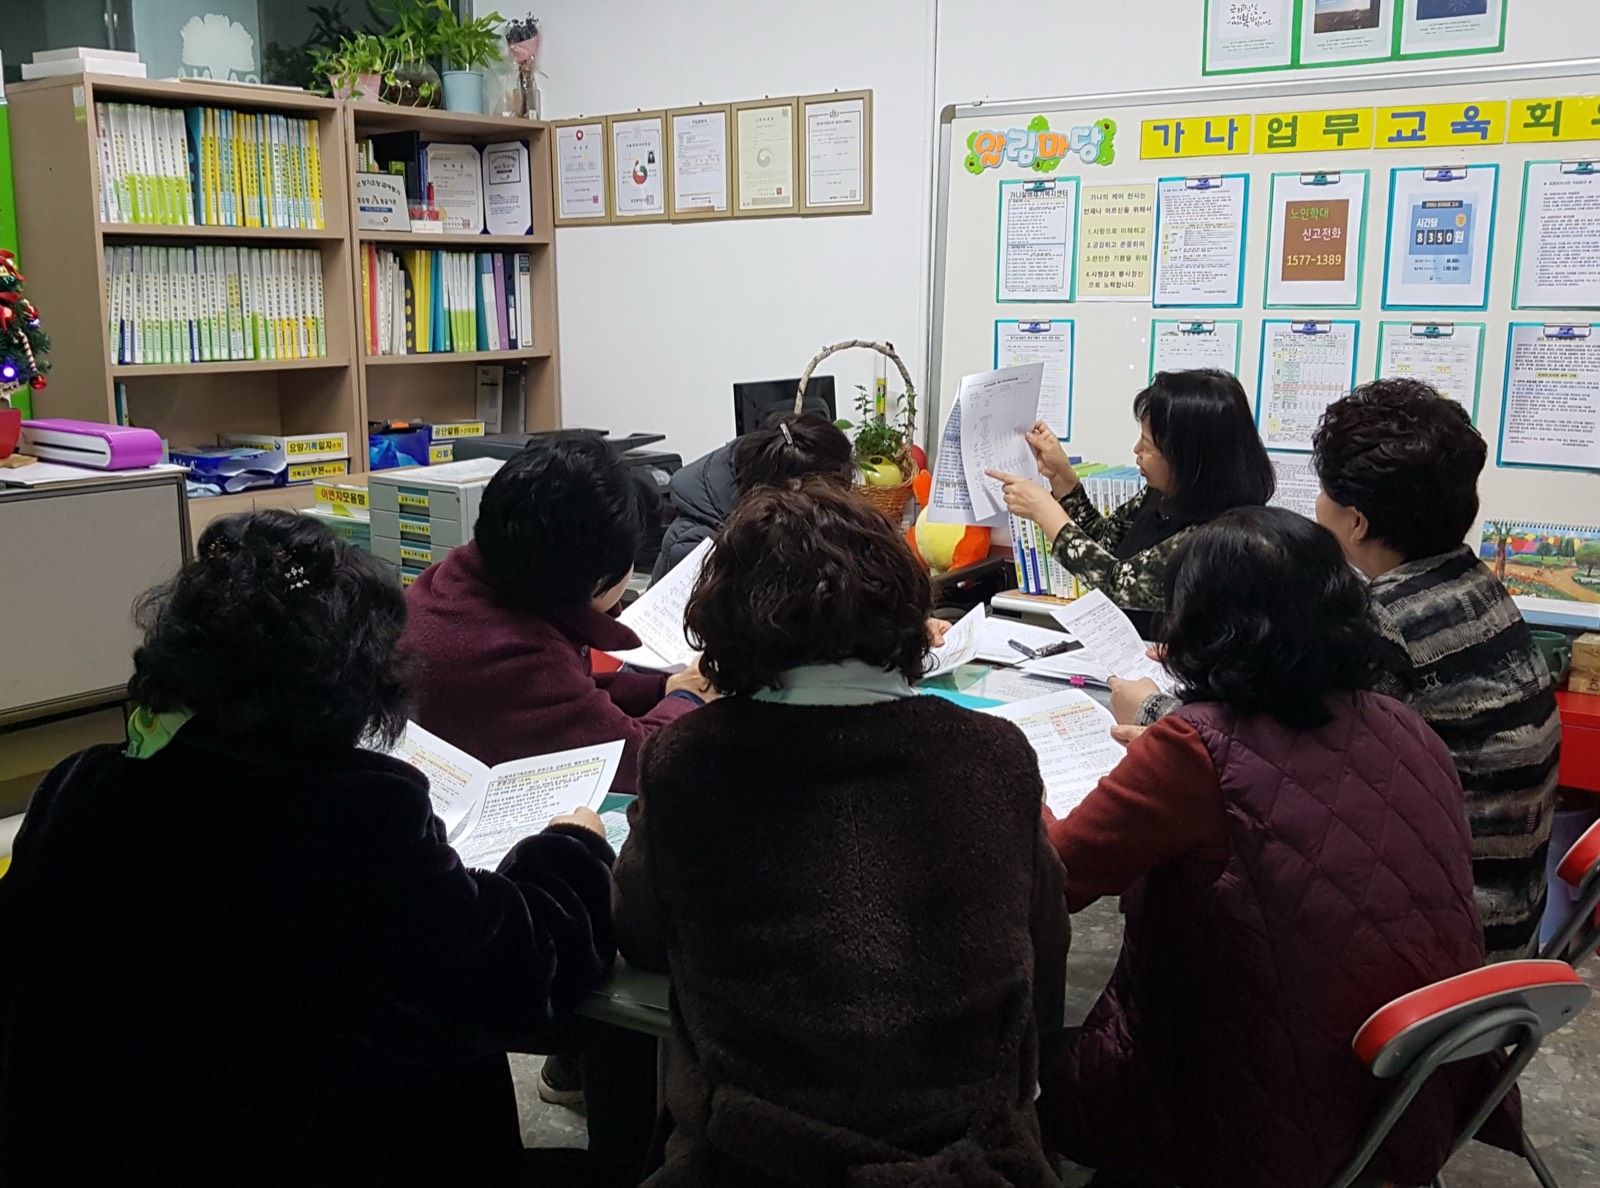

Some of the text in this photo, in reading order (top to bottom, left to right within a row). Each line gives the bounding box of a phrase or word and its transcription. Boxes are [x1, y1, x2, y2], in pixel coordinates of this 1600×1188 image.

[1152, 120, 1239, 153] 가나
[1267, 113, 1360, 149] 업무
[1387, 105, 1492, 142] 교육
[974, 126, 1104, 169] 알림마당
[1090, 193, 1108, 201] 가나의
[1083, 205, 1152, 215] 언제나 어르신을 위해서
[1289, 207, 1330, 220] 노인학대
[1416, 217, 1438, 228] 시간당
[1302, 227, 1342, 241] 신고전화
[1286, 254, 1342, 266] 1577-1389
